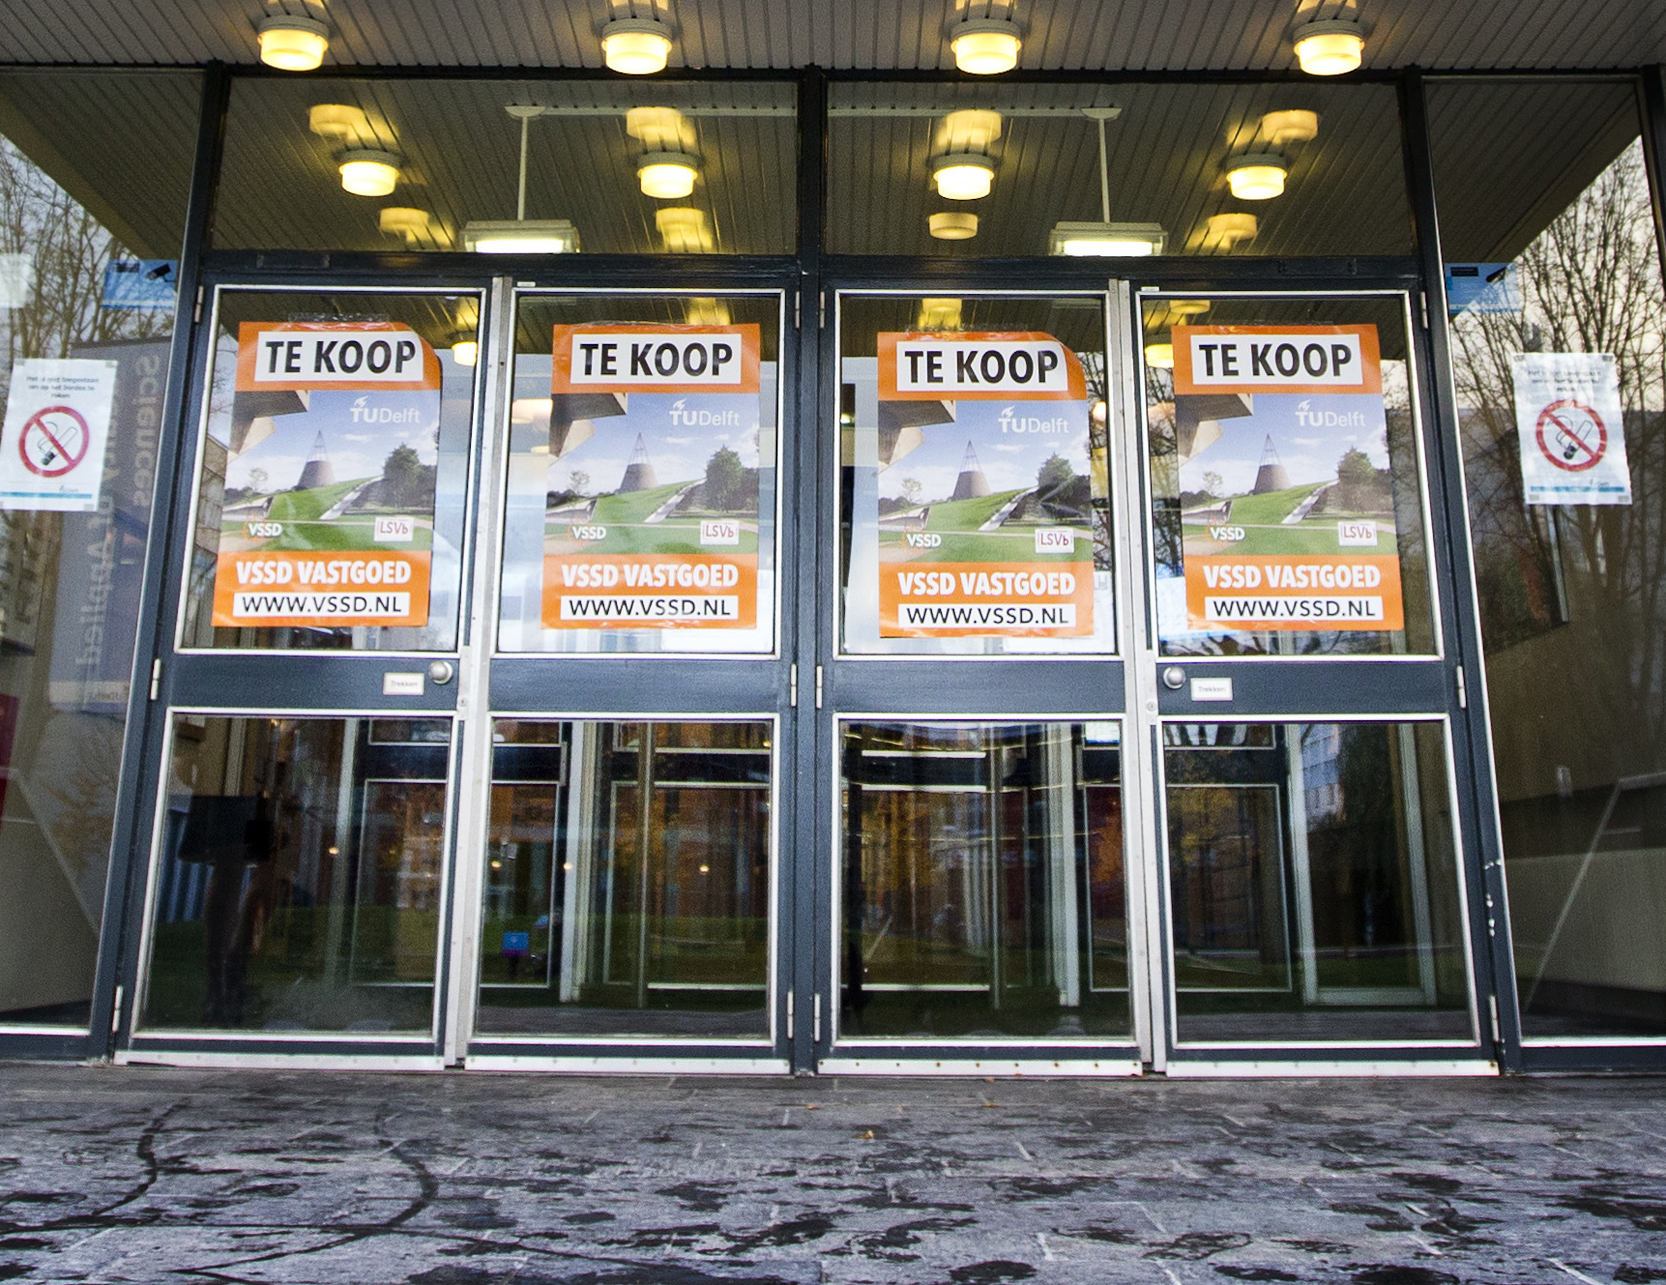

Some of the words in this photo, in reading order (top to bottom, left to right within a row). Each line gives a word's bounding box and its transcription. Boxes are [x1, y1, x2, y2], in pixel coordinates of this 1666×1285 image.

[266, 341, 302, 374] TE
[314, 340, 415, 374] KOOP
[580, 342, 618, 376] TE
[630, 341, 734, 376] KOOP
[904, 350, 944, 384] TE
[956, 350, 1059, 384] KOOP
[1199, 343, 1238, 377] TE
[1251, 342, 1352, 377] KOOP
[248, 523, 282, 537] VSSD
[572, 526, 607, 540] VSSD
[1210, 527, 1245, 541] VSSD
[906, 534, 942, 549] VSSD
[236, 561, 291, 585] VSSD
[297, 561, 411, 585] VASTGOED
[562, 564, 618, 588] VSSD
[623, 563, 739, 588] VASTGOED
[898, 571, 956, 596] VSSD
[960, 571, 1076, 596] VASTGOED
[1204, 566, 1260, 589] VSSD
[1266, 565, 1381, 589] VASTGOED
[242, 596, 402, 614] WWW.VSSD.NL
[568, 598, 731, 617] WWW.VSSD.NL
[1213, 600, 1375, 618] WWW.VSSD.NL
[906, 607, 1069, 625] WWW.VSSD.NL
